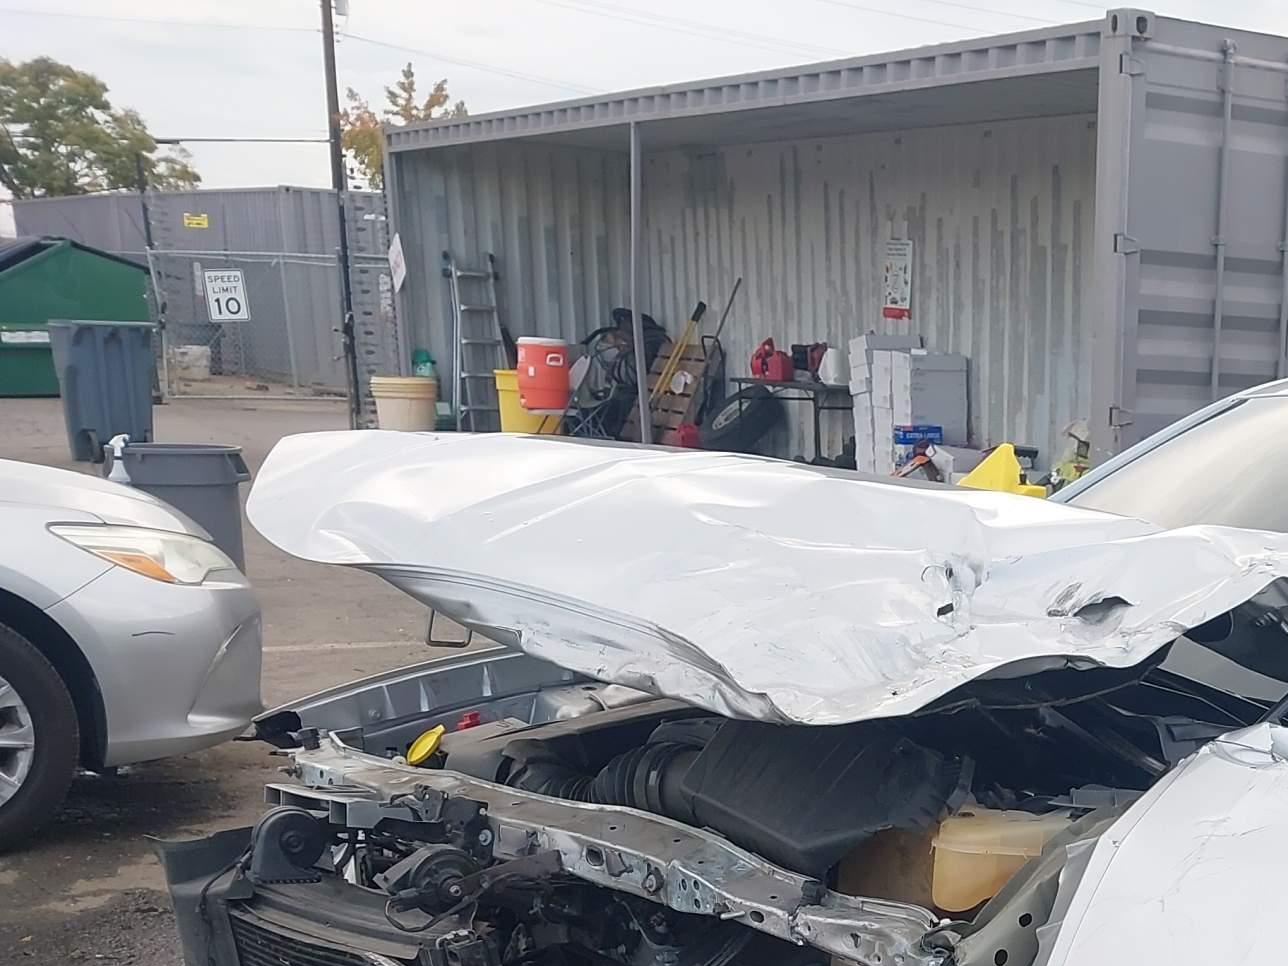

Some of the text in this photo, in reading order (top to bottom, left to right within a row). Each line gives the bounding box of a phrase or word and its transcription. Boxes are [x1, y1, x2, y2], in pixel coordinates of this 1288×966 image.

[207, 275, 240, 283] SPEED
[212, 286, 238, 294] LIMIT
[214, 297, 241, 315] 10
